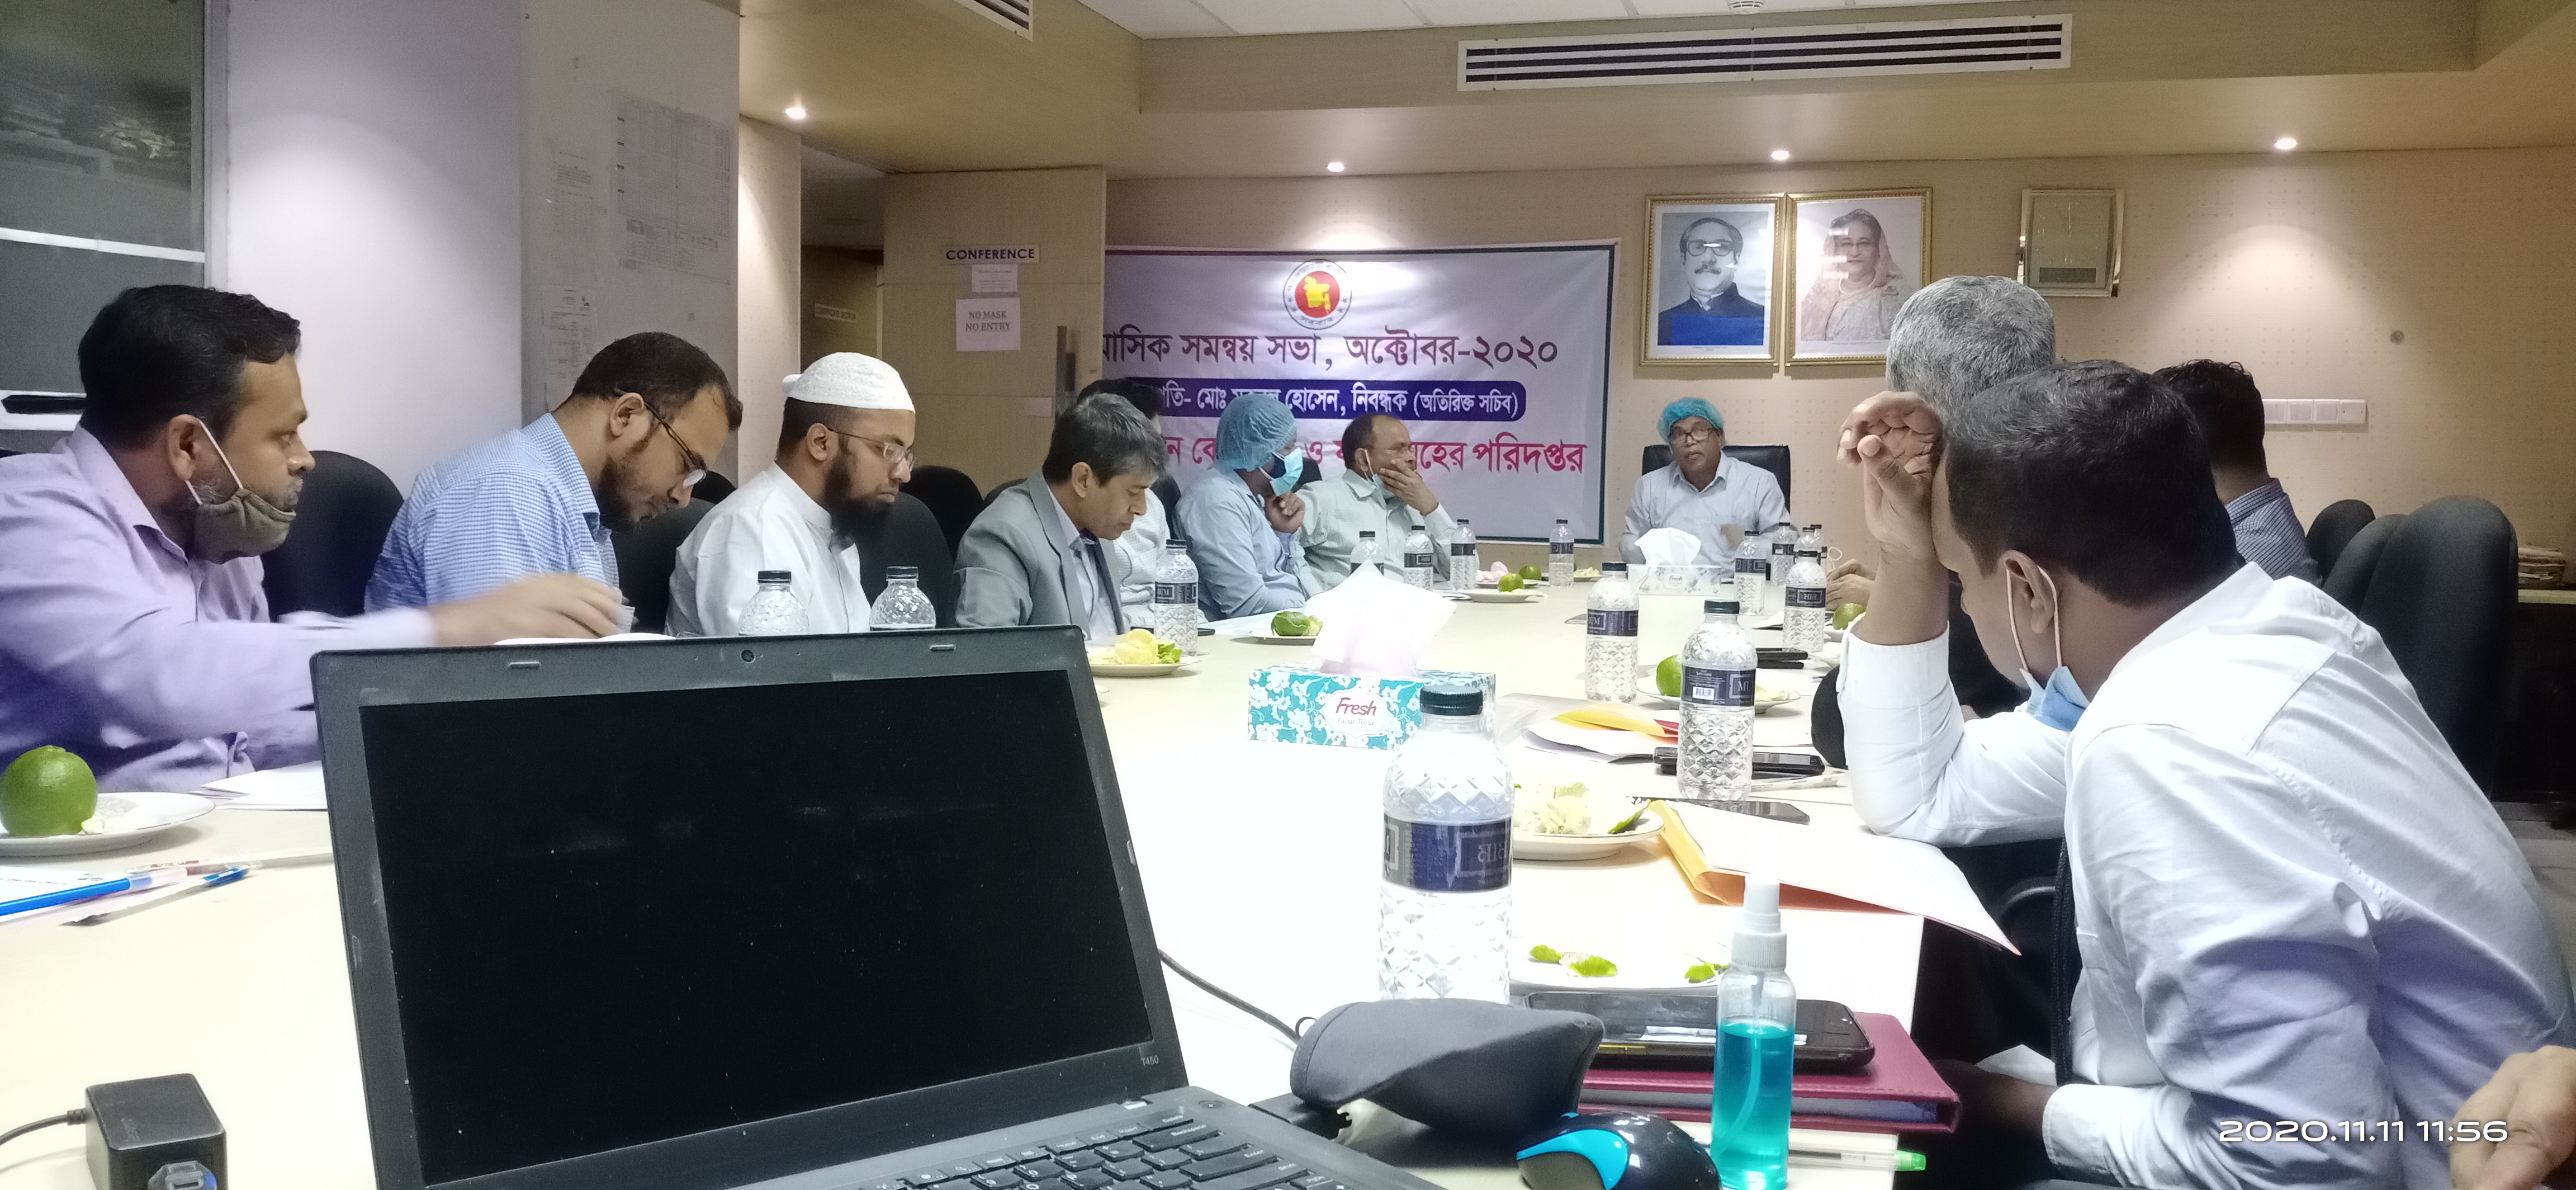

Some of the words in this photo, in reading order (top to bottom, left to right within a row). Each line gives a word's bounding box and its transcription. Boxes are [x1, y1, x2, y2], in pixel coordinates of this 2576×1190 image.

[946, 249, 1035, 260] CONFERENCE
[982, 311, 1007, 320] MASK
[965, 323, 979, 332] NO
[981, 322, 1011, 332] ENTRY
[1179, 335, 1259, 363] সমন্বয়
[1350, 382, 1409, 412] নিবন্ধক
[1478, 388, 1518, 418] সচিব)
[1472, 432, 1588, 474] পরিদপ্তর
[1336, 697, 1377, 716] Fresh
[1140, 1055, 1159, 1066] T450
